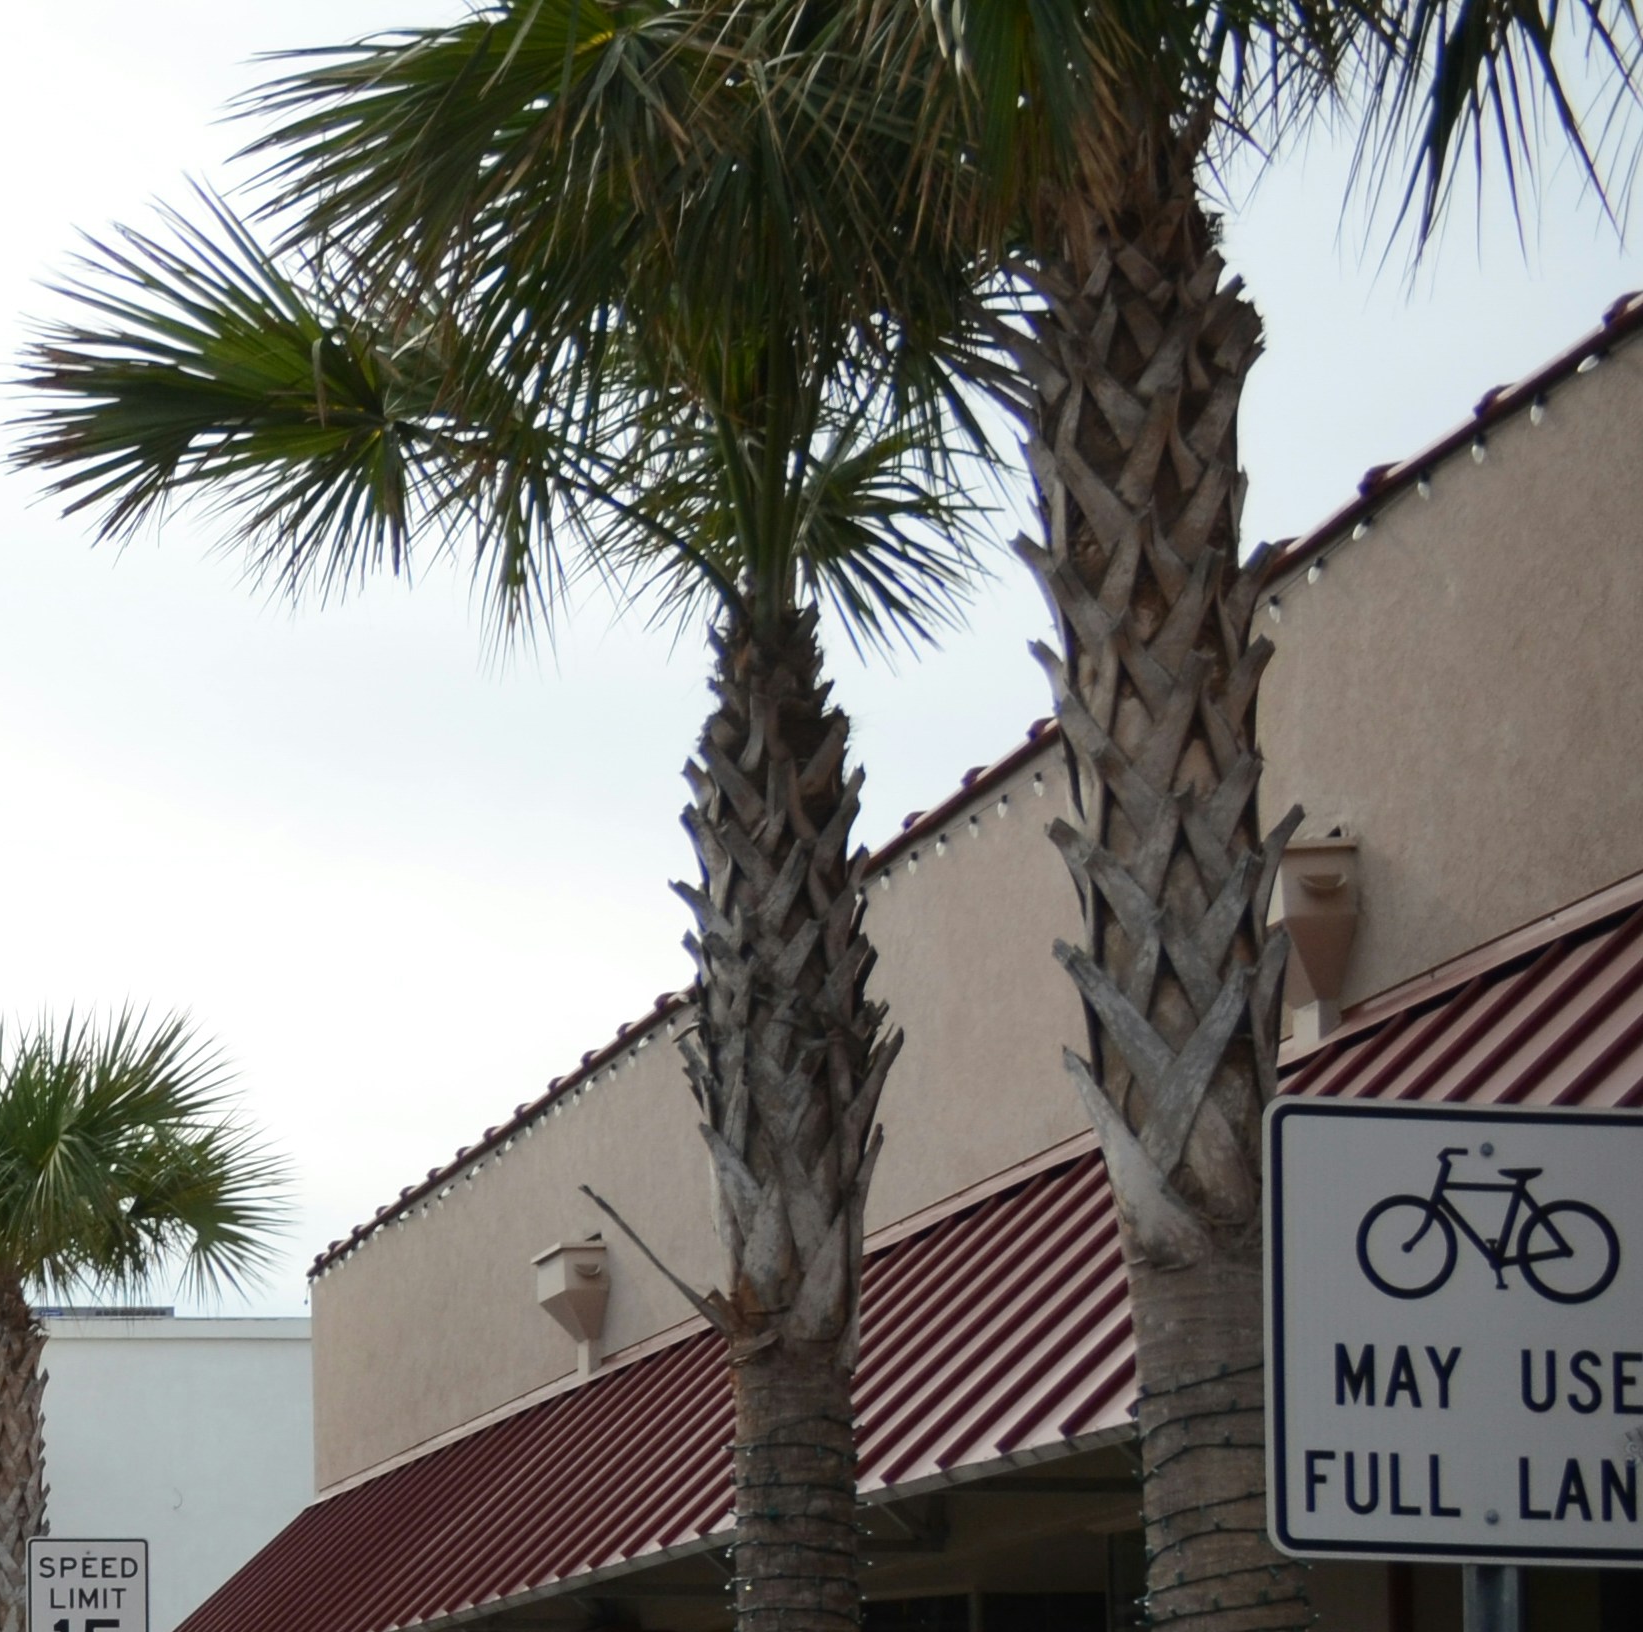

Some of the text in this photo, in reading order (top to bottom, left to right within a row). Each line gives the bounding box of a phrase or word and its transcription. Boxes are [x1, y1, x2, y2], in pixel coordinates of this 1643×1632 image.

[1334, 1342, 1643, 1414] MAY USE
[1303, 1448, 1638, 1522] FULL LAN
[38, 1556, 139, 1580] SPEED
[49, 1587, 127, 1610] LIMIT
